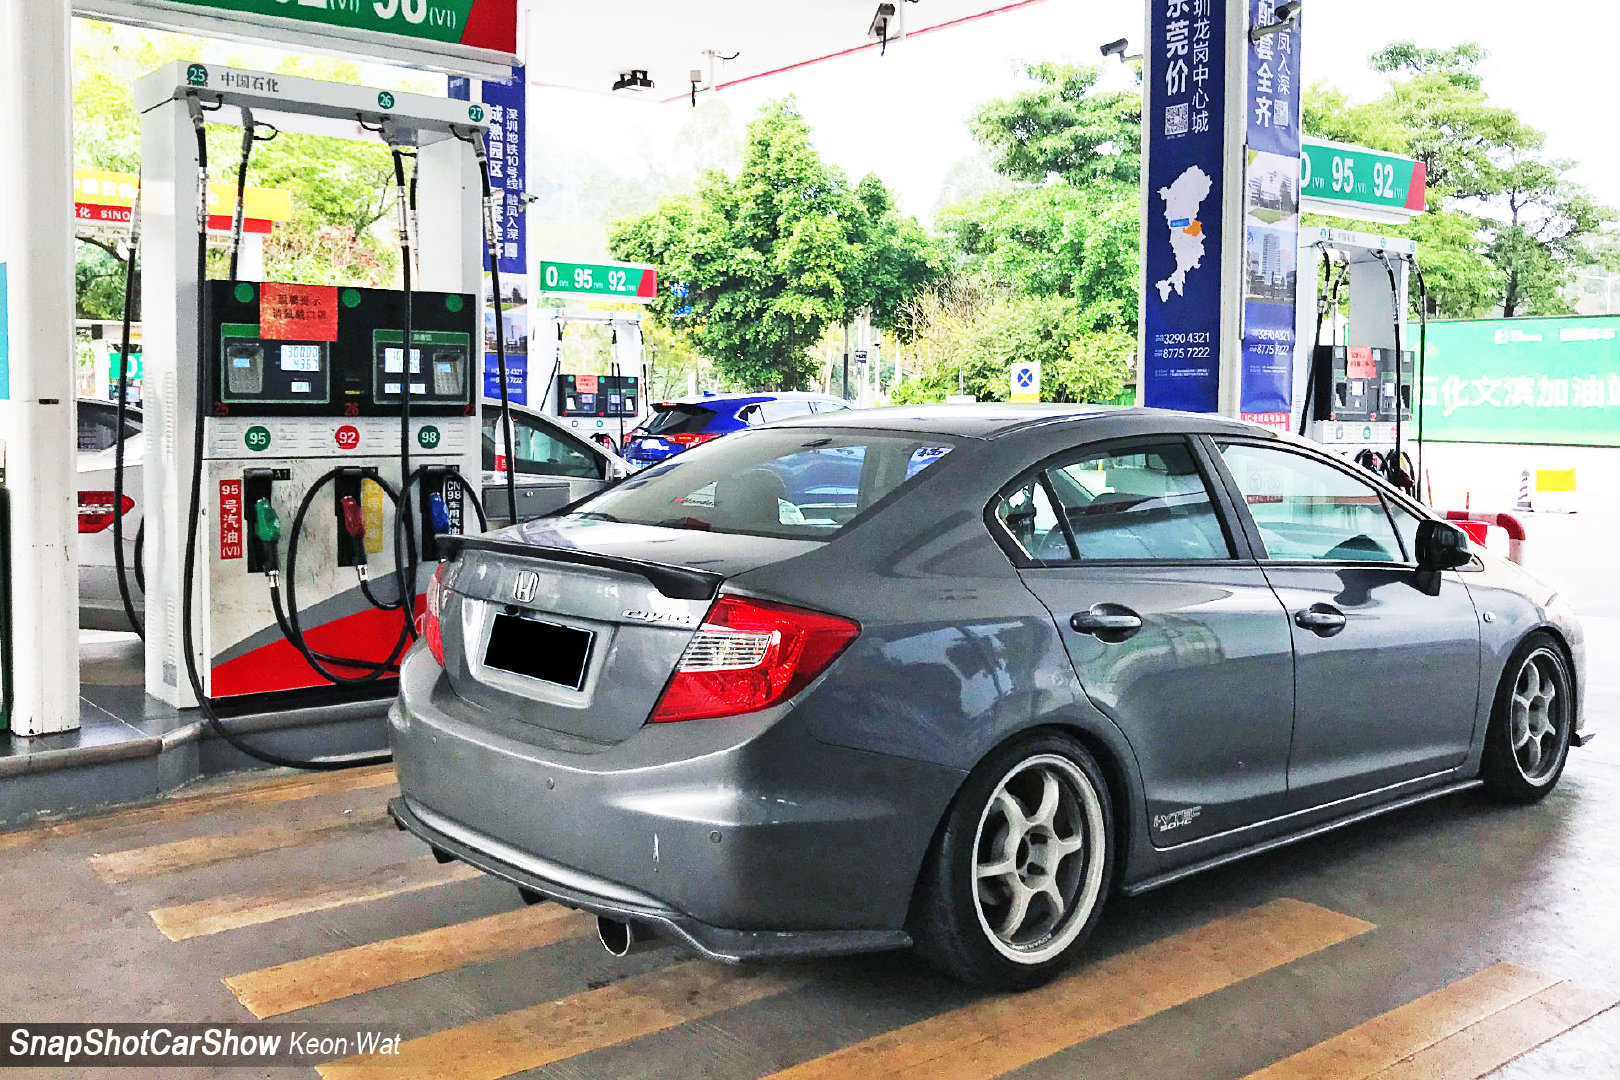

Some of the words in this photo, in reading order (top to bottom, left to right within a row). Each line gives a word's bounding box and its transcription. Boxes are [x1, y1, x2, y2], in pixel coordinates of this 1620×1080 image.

[429, 7, 456, 30] (VI)
[1277, 20, 1291, 95] 凤入深
[190, 67, 205, 82] 25
[221, 71, 280, 93] 中国石化
[380, 93, 392, 107] 26
[470, 107, 482, 119] 27
[1331, 156, 1355, 194] 95
[1373, 161, 1394, 199] 92
[545, 265, 558, 288] 0
[574, 267, 594, 289] 95
[608, 269, 627, 292] 92
[1163, 333, 1186, 345] 3290
[1187, 331, 1210, 343] 4321
[1162, 348, 1185, 359] 8775
[1186, 346, 1210, 358] 7222
[214, 402, 229, 415] 25
[344, 402, 359, 416] 26
[249, 432, 266, 445] 95
[339, 431, 356, 444] 92
[421, 431, 437, 443] 98
